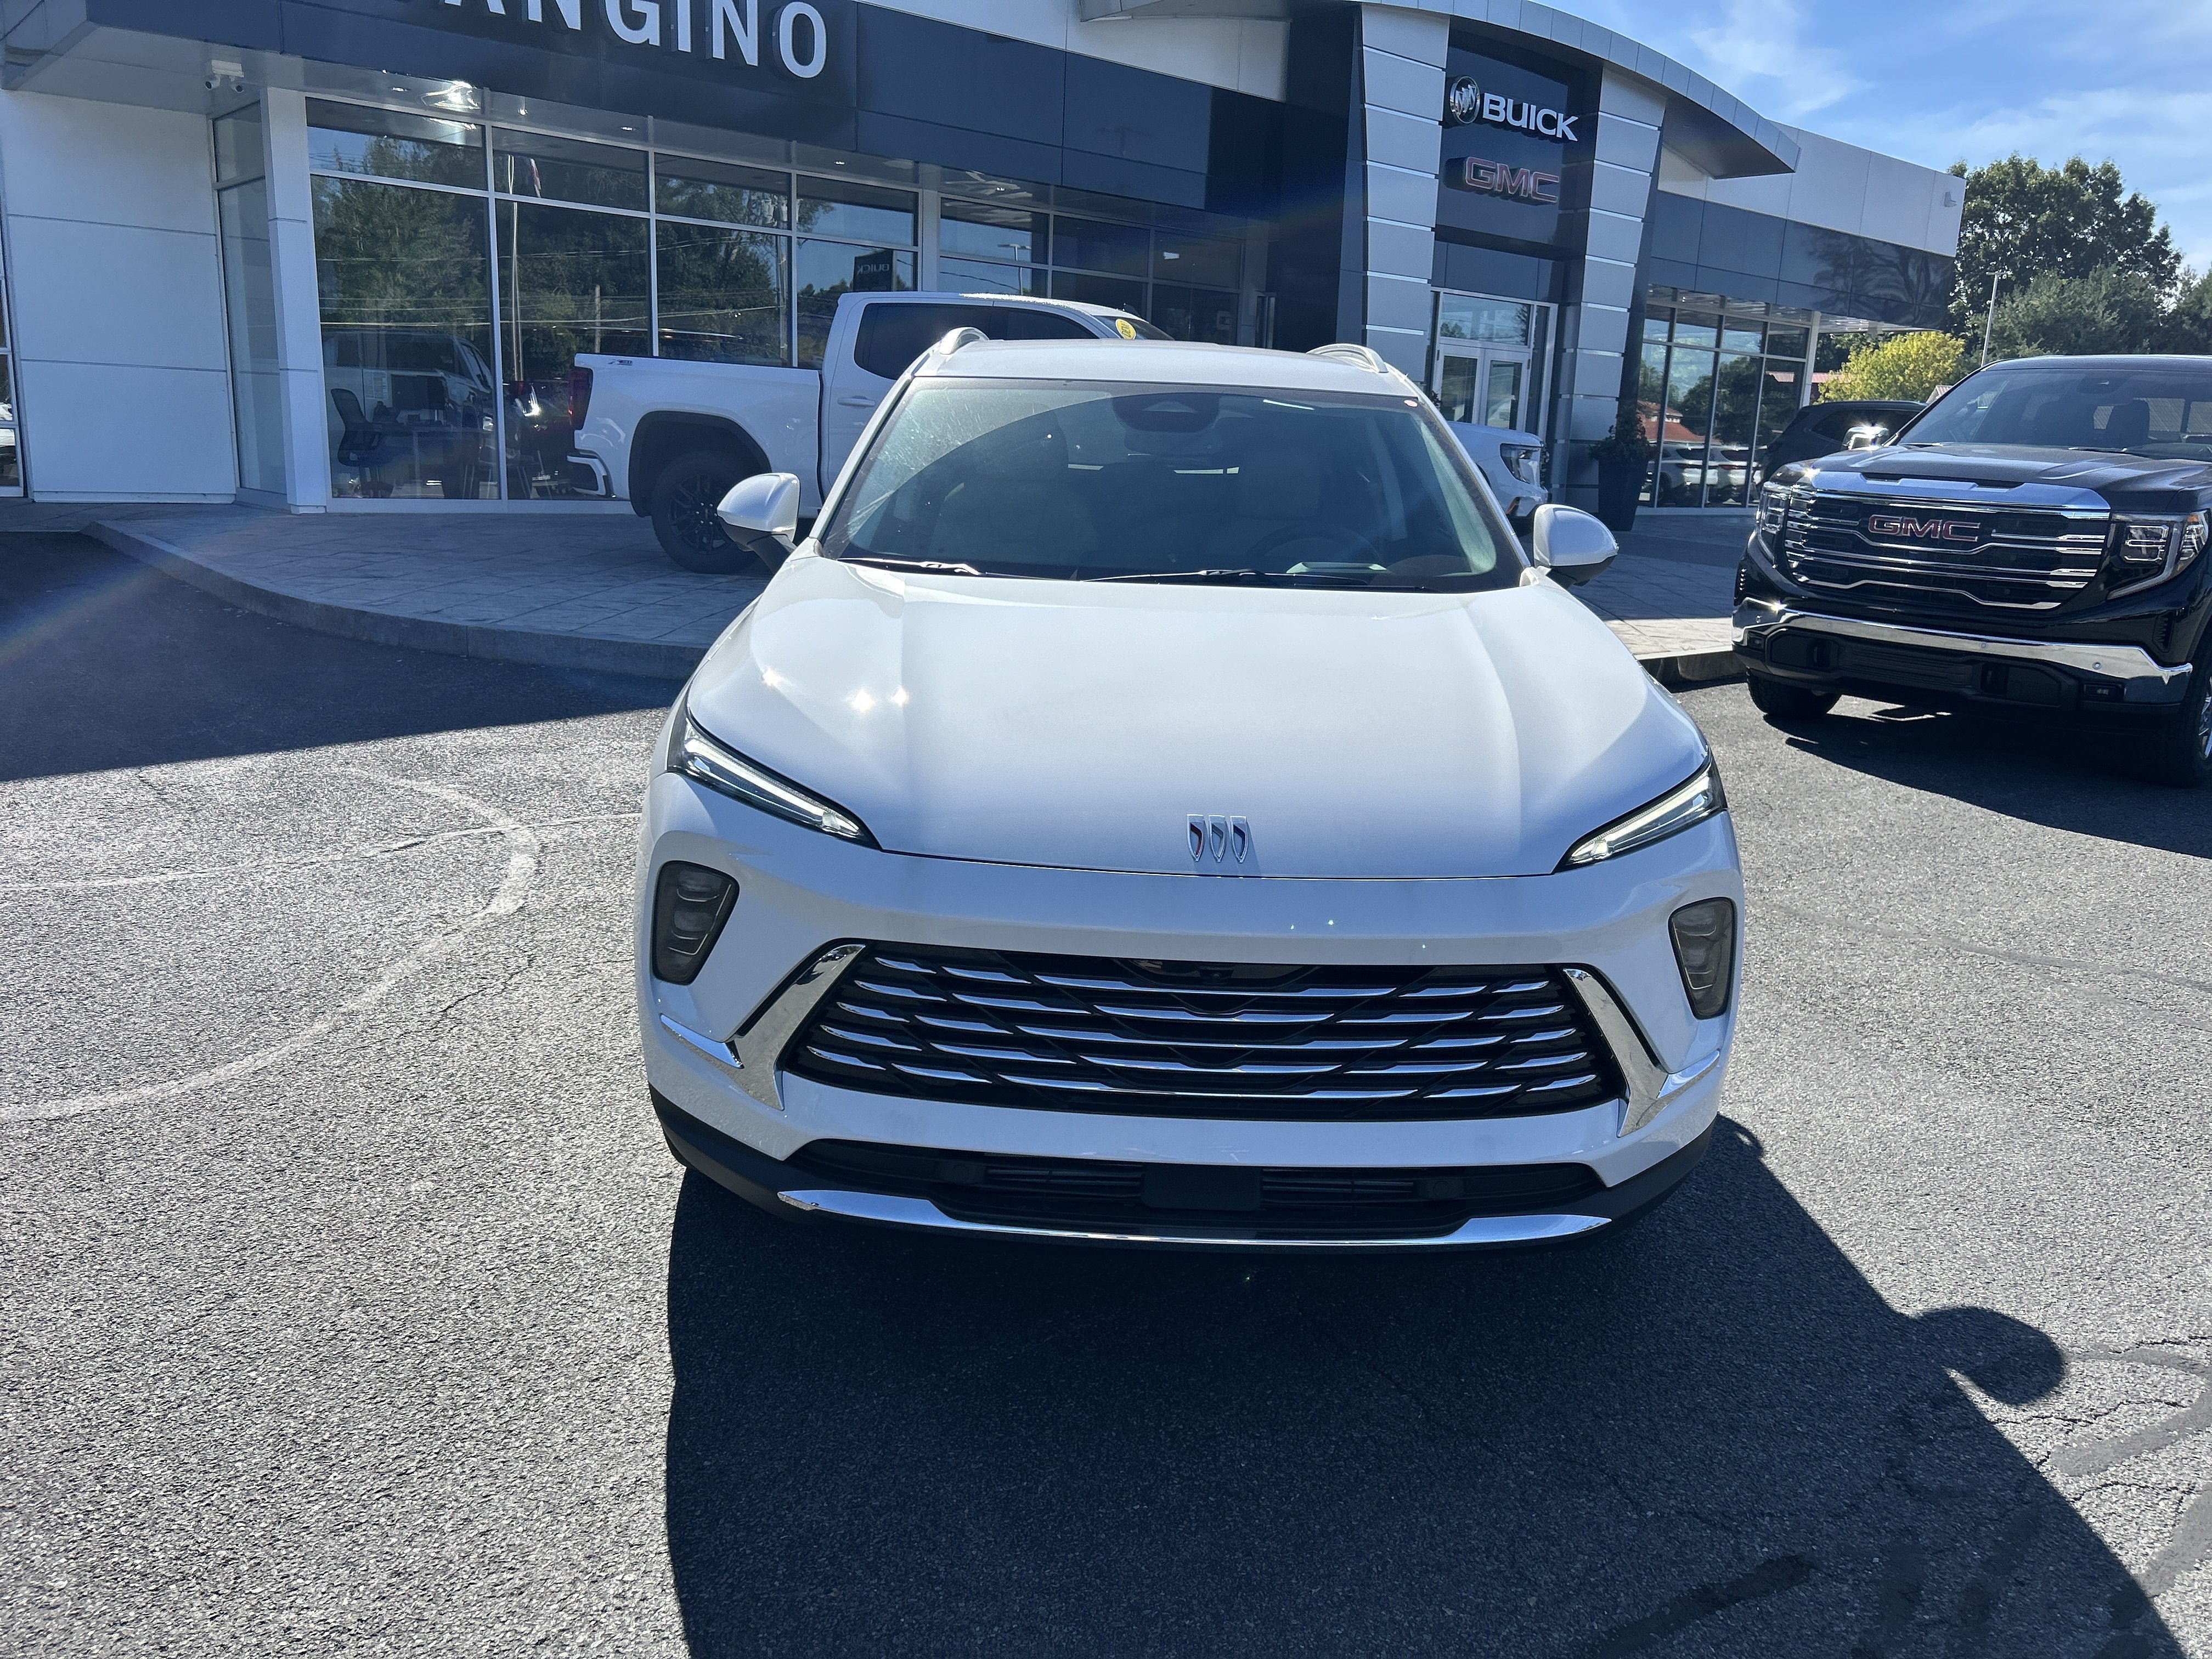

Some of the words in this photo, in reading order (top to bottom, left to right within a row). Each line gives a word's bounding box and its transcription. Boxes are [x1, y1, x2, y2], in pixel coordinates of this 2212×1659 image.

[444, 0, 827, 79] GINO
[1482, 92, 1579, 142] BUICK
[1465, 156, 1560, 204] GMC
[1868, 514, 1981, 542] GMC
